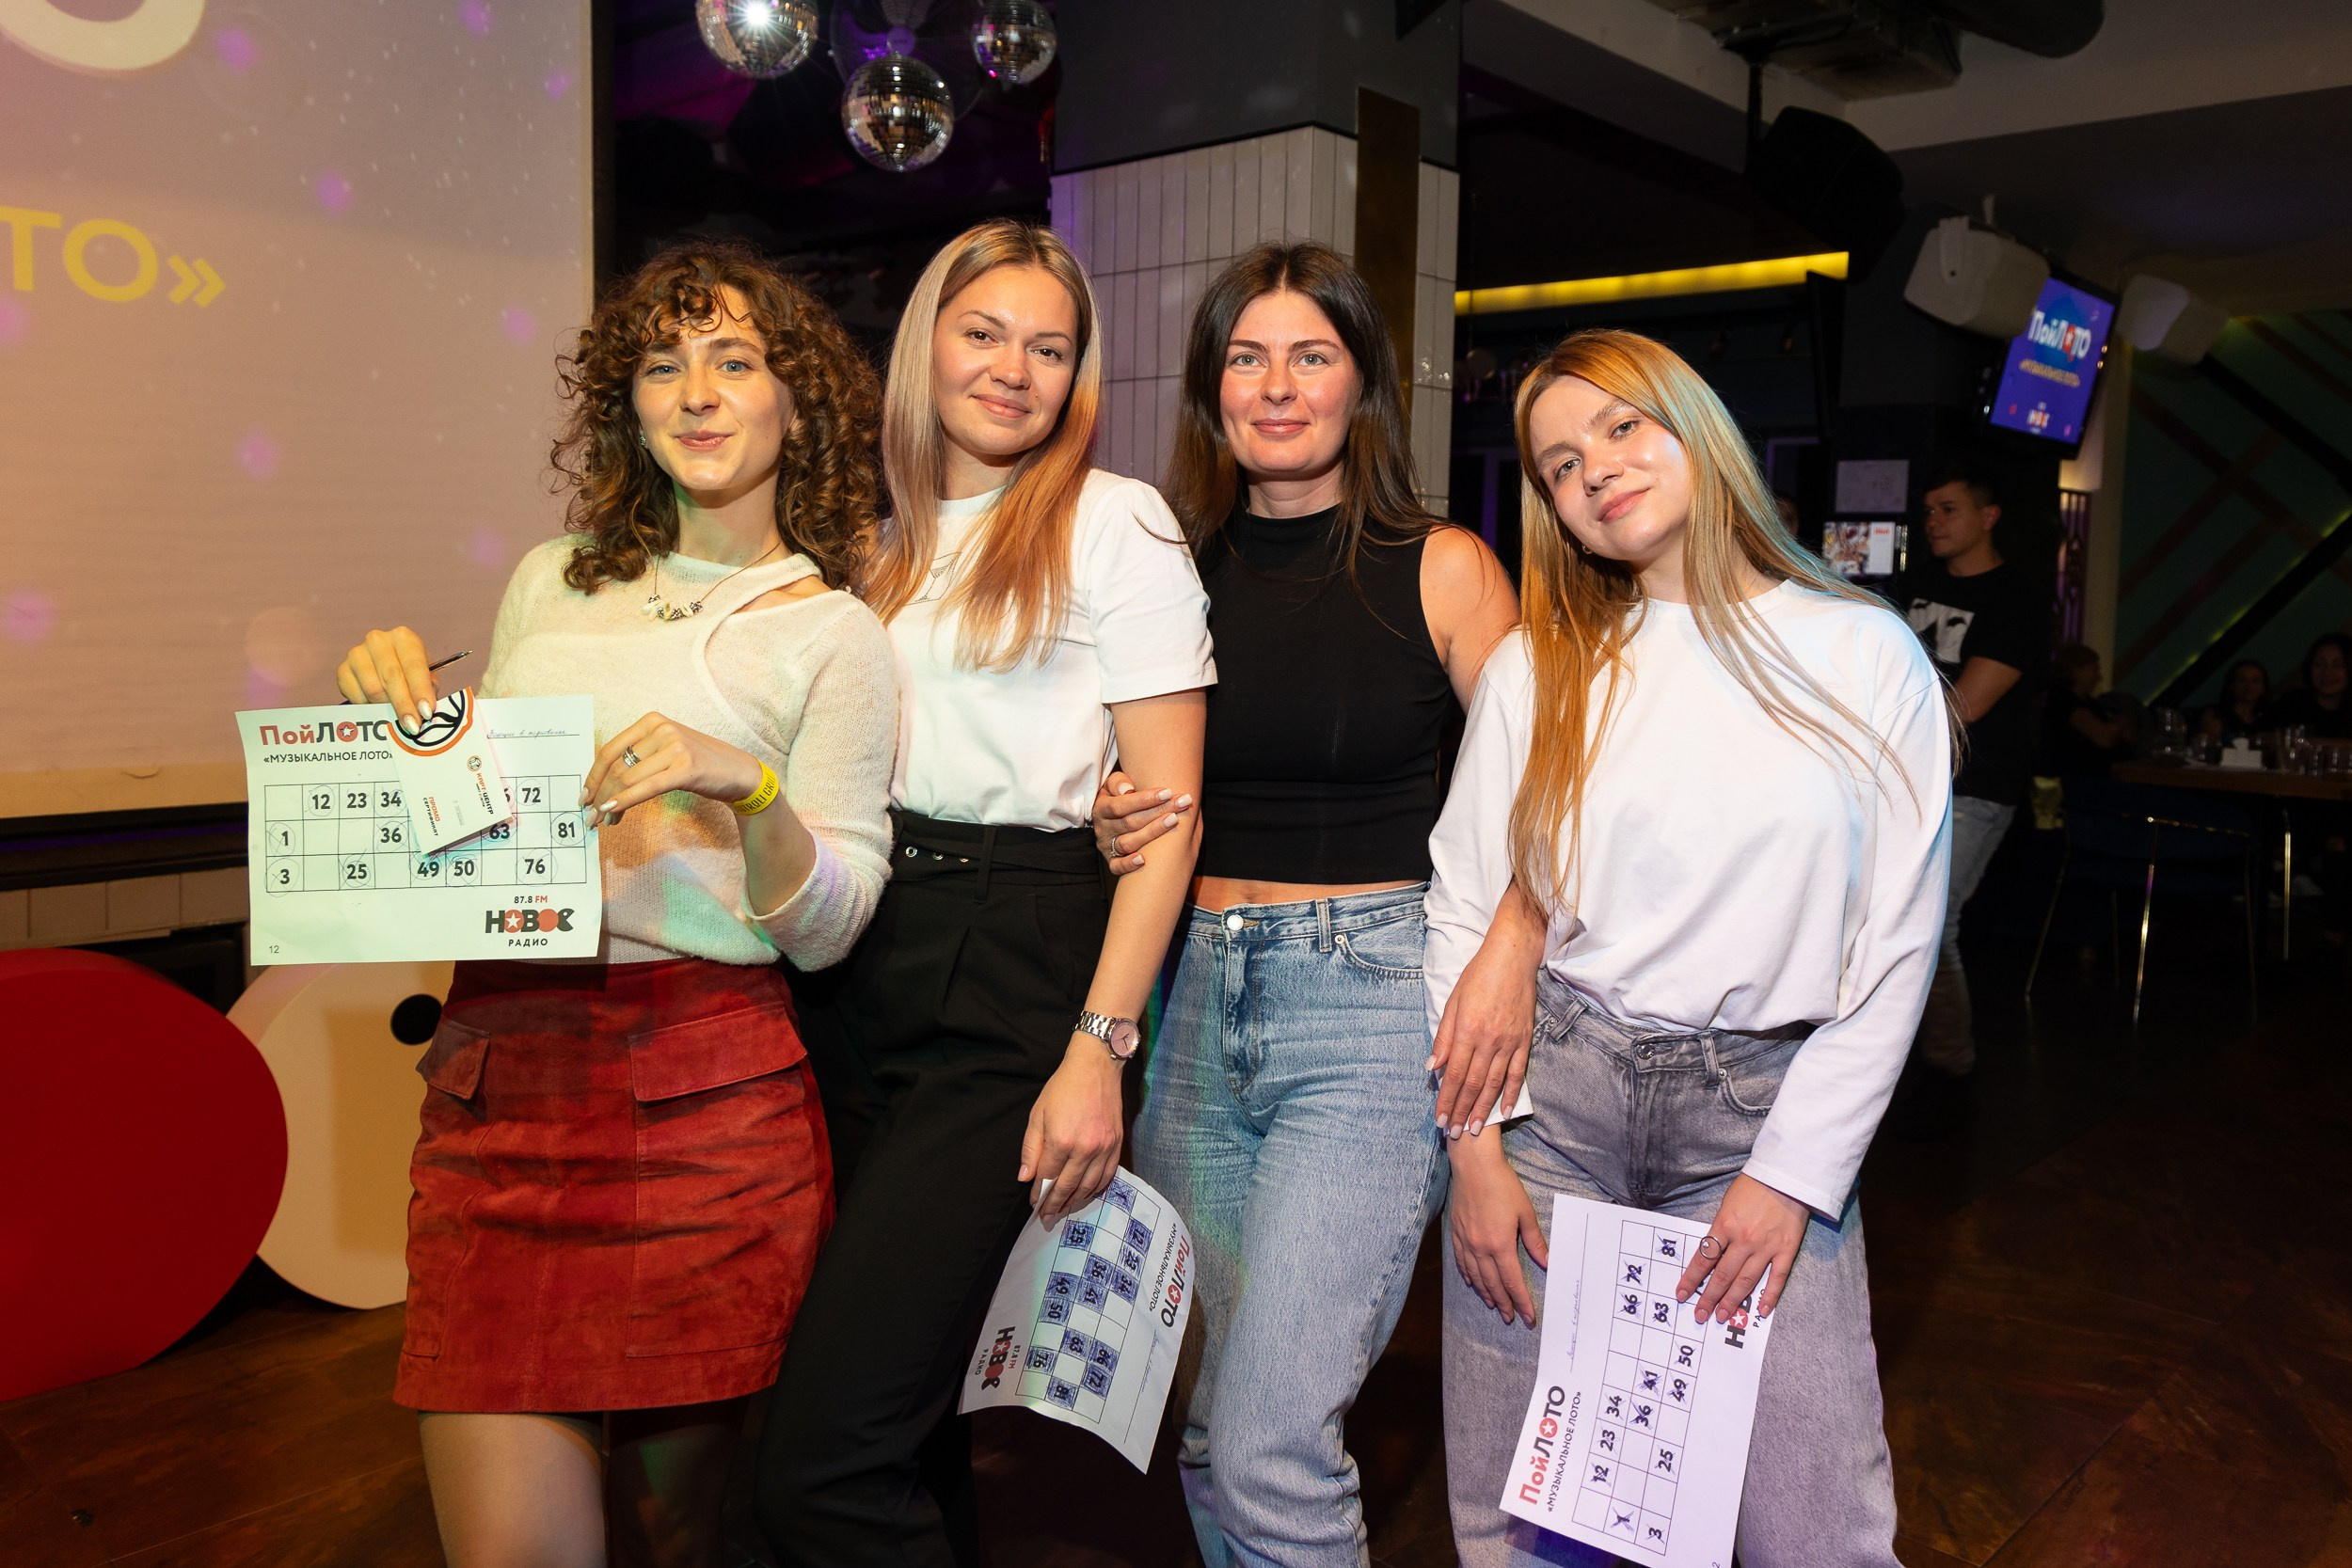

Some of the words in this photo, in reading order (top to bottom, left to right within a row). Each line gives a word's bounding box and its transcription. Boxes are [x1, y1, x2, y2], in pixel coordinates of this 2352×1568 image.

[263, 752, 358, 764] «МУЗЫКАЛЬНОЕ
[311, 794, 330, 810] 12
[346, 792, 367, 809] 23
[380, 791, 402, 808] 34
[521, 787, 542, 803] 72
[428, 797, 440, 822] ПРОМО
[281, 831, 289, 847] 1
[380, 827, 403, 844] 36
[489, 823, 511, 840] 63
[558, 821, 576, 838] 81
[279, 868, 291, 885] 3
[346, 863, 368, 879] 25
[417, 861, 439, 878] 49
[453, 860, 474, 877] 50
[524, 858, 546, 875] 76
[514, 895, 533, 904] 87.8
[269, 944, 279, 954] 12
[508, 938, 548, 948] РАДИО
[1069, 1226, 1087, 1243] 25
[1132, 1227, 1145, 1245] 12
[1091, 1260, 1107, 1280] 36
[1626, 1264, 1642, 1284] 72
[1055, 1277, 1071, 1294] 49
[1118, 1275, 1132, 1294] 34
[1161, 1234, 1190, 1328] ПойЛОТО
[1084, 1288, 1098, 1306] 41
[1623, 1293, 1638, 1315] 66
[1047, 1303, 1064, 1320] 50
[1635, 1404, 1651, 1428] 36
[1643, 1370, 1659, 1391] 41
[1653, 1302, 1669, 1323] 63
[1661, 1238, 1677, 1258] 81
[1069, 1336, 1084, 1354] 63
[975, 1348, 990, 1376] РАДИО
[1008, 1359, 1017, 1370] FM
[1033, 1354, 1050, 1369] 76
[1677, 1344, 1694, 1368] 50
[1087, 1370, 1104, 1388] 72
[1672, 1378, 1687, 1402] 49
[1606, 1395, 1622, 1418] 34
[1519, 1386, 1565, 1505] ПойЛОТО
[1600, 1429, 1615, 1451] 23
[1547, 1427, 1575, 1513] «МУЗЫКАЛЬНОЕ
[1567, 1391, 1581, 1427] ЛОТО»
[1658, 1449, 1674, 1472] 25
[1648, 1527, 1662, 1540] 3
